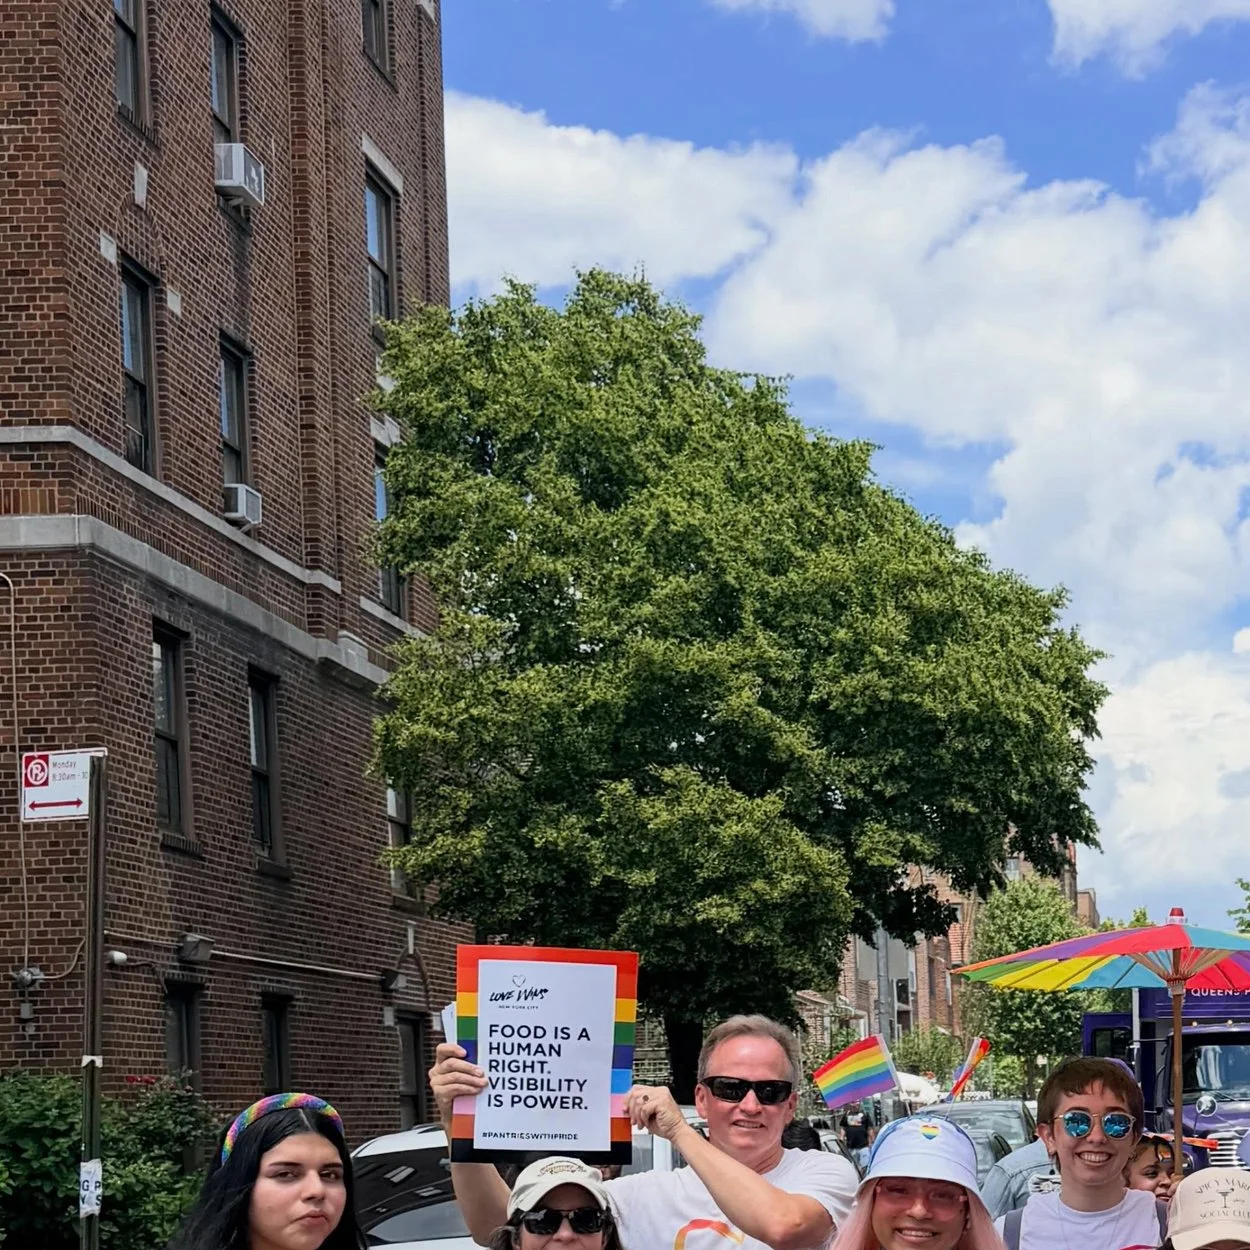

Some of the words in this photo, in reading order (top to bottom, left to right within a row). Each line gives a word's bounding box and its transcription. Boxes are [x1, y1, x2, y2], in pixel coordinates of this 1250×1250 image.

[489, 990, 515, 1002] LOVE
[489, 1024, 547, 1039] FOOD
[554, 1026, 571, 1040] IS
[577, 1028, 591, 1041] A
[488, 1042, 561, 1057] HUMAN
[488, 1059, 552, 1074] RIGHT.
[488, 1077, 588, 1092] VISIBILITY
[487, 1094, 504, 1108] IS
[511, 1095, 589, 1110] POWER.
[482, 1131, 579, 1140] #PANTRIESWITHPRIDE
